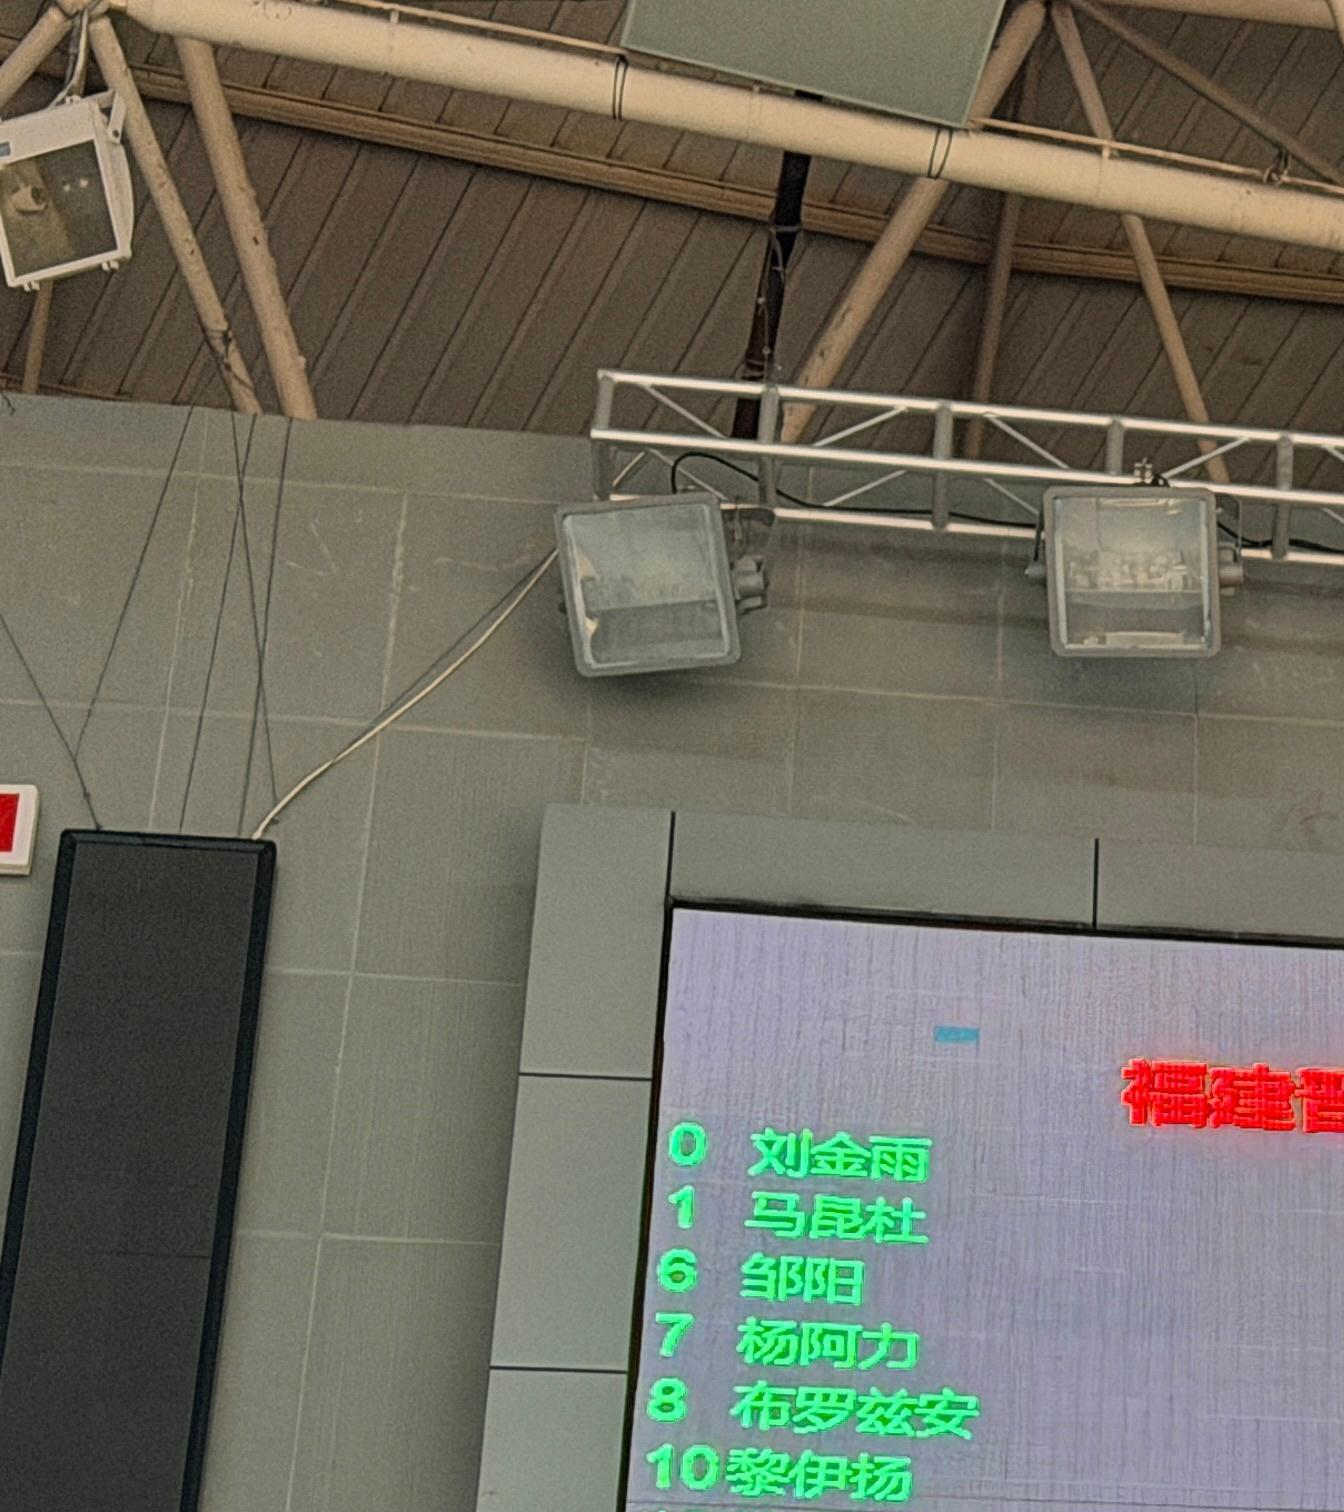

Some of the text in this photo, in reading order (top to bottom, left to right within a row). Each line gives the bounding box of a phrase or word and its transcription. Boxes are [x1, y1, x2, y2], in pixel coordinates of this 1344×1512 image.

[666, 1120, 935, 1185] 0 刘金雨
[668, 1184, 930, 1247] 1 马昆杜
[656, 1246, 868, 1309] 6 邹阳
[654, 1310, 922, 1372] 7 杨阿力
[646, 1375, 690, 1425] 8
